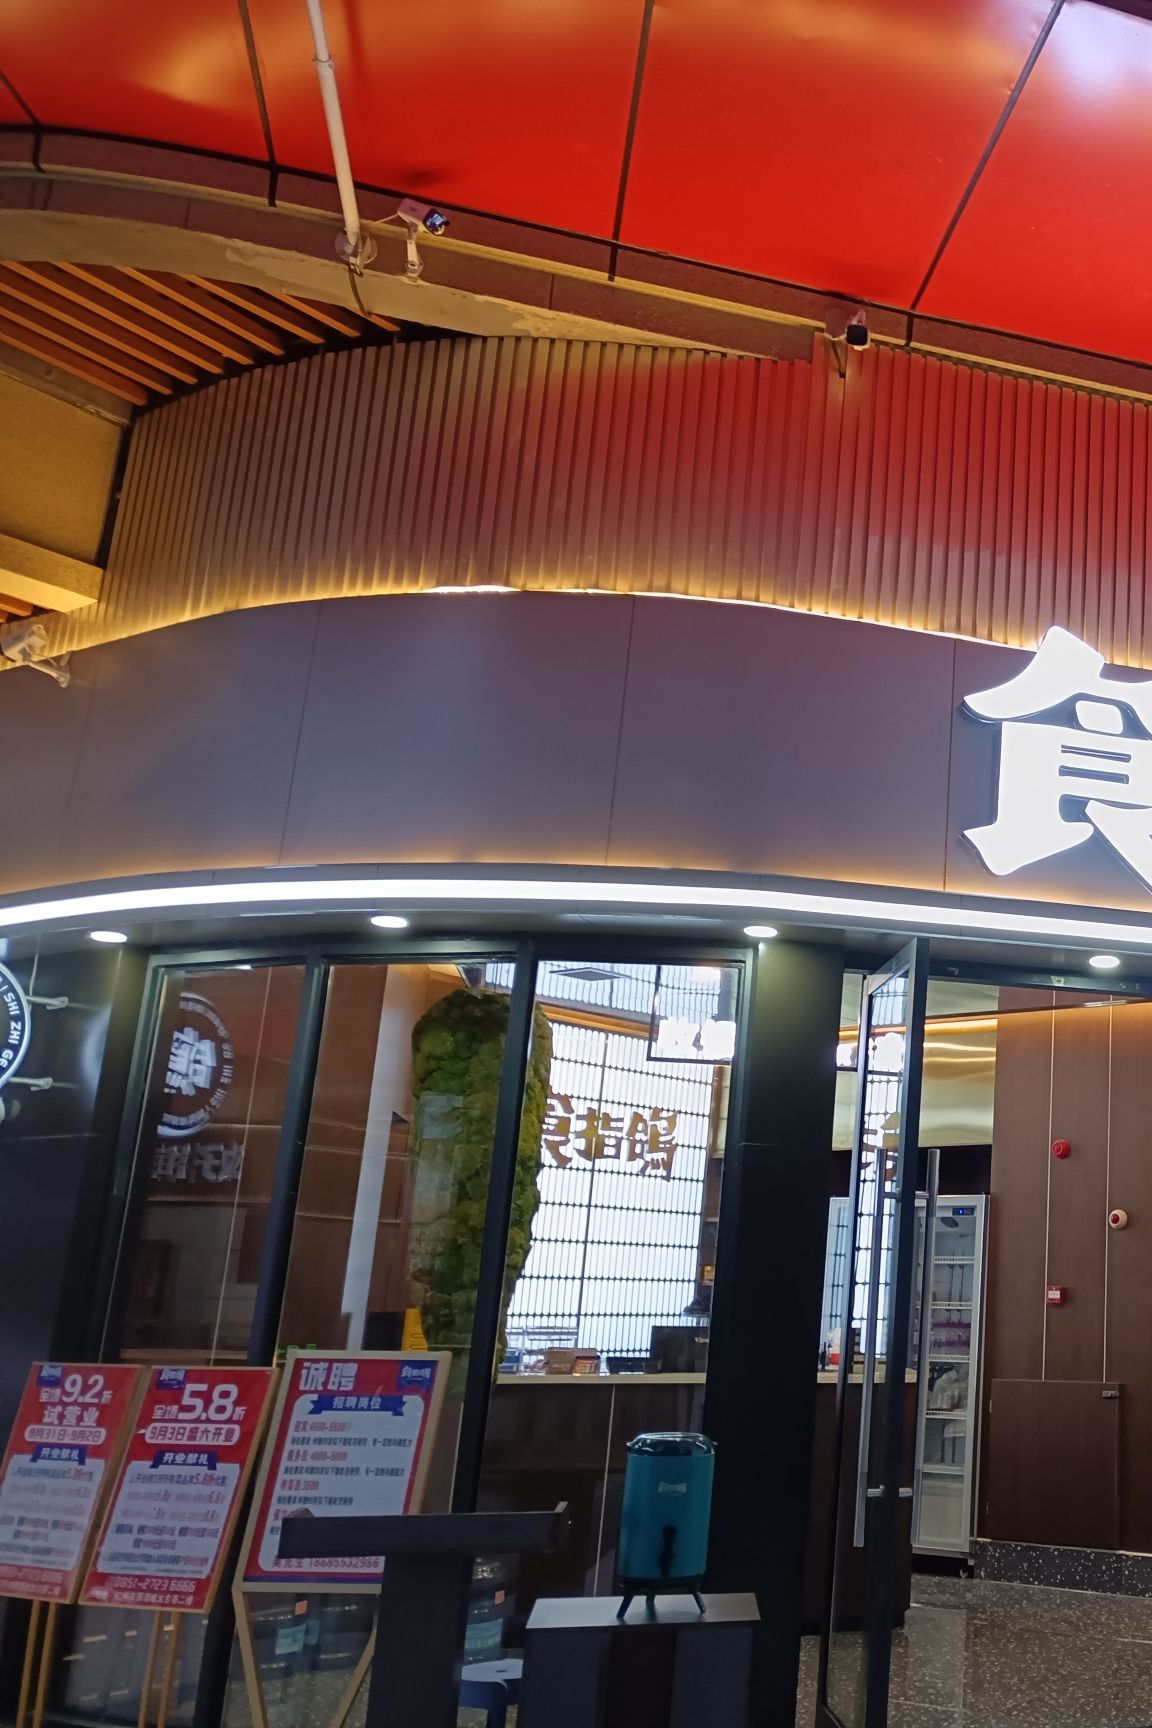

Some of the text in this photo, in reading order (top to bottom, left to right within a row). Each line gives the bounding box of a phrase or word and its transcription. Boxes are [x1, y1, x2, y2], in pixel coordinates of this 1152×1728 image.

[3, 992, 20, 1015] SHI
[8, 1021, 21, 1044] ZHI
[299, 1361, 358, 1391] 诚聘
[42, 1405, 100, 1426] 试营业
